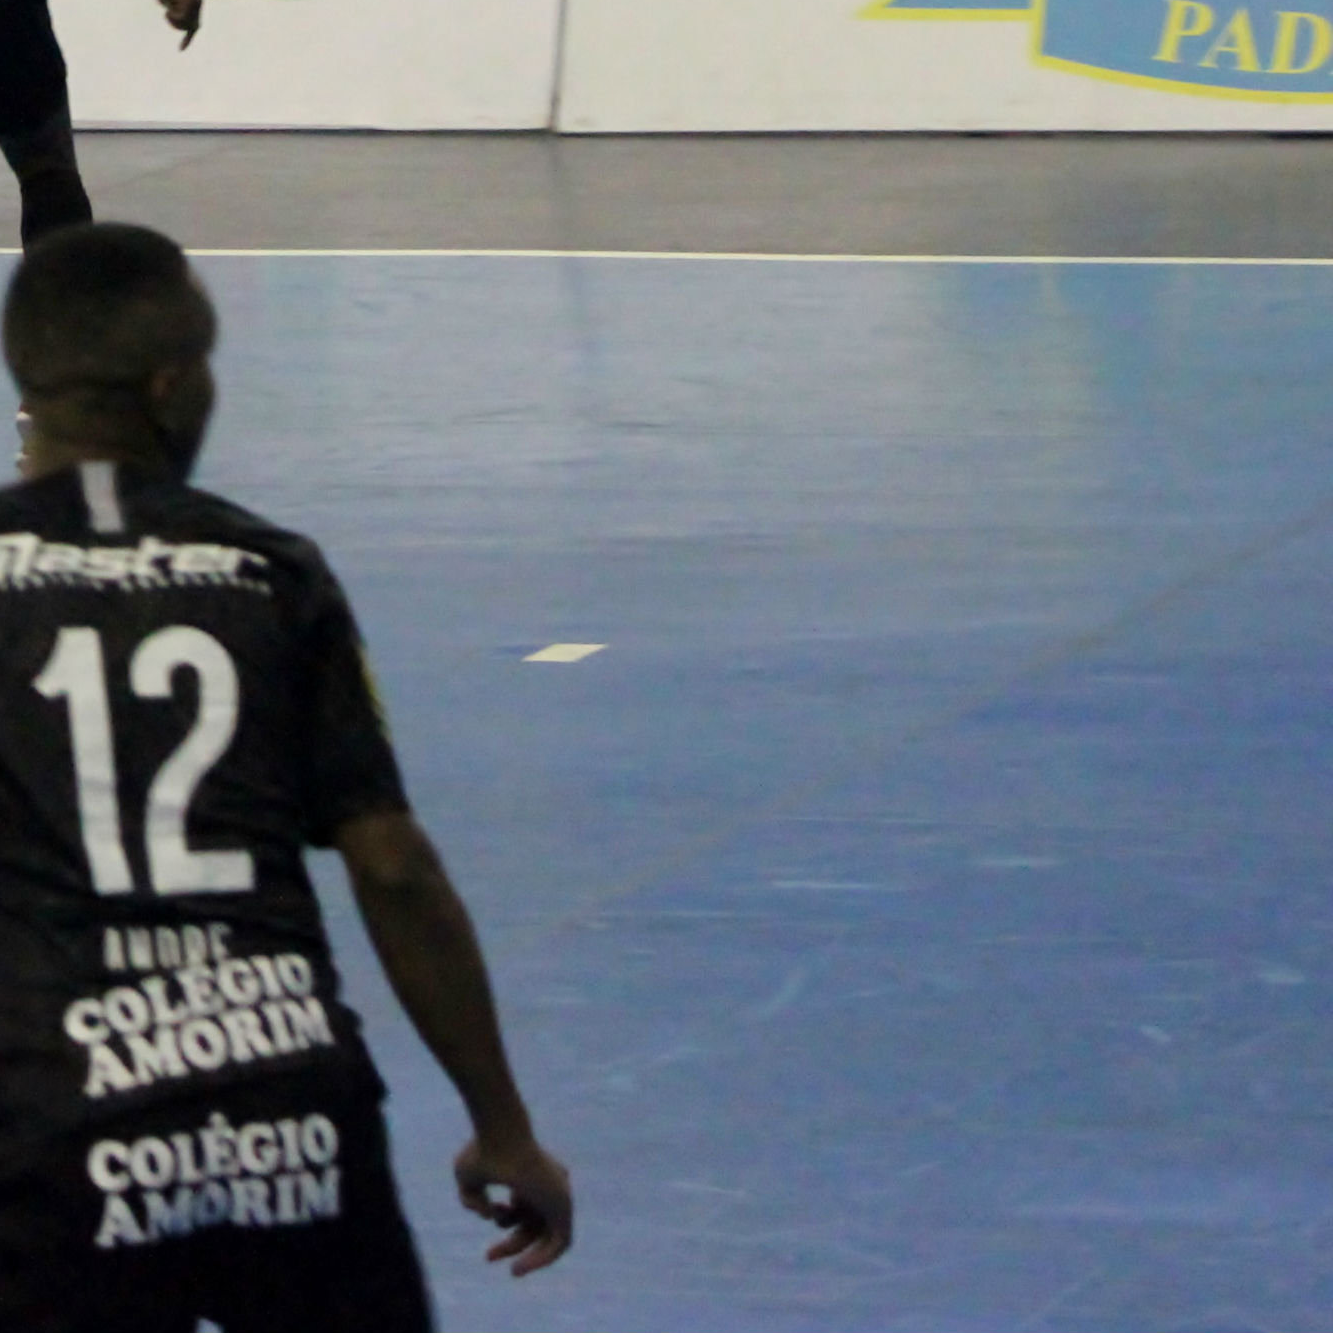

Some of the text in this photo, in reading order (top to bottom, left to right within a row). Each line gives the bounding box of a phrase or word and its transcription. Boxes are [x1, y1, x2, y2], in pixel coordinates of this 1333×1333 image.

[32, 624, 255, 896] 12
[84, 995, 335, 1099] AMORIM
[87, 1111, 339, 1194] COLÉGIO
[95, 1166, 340, 1249] AMORIM
